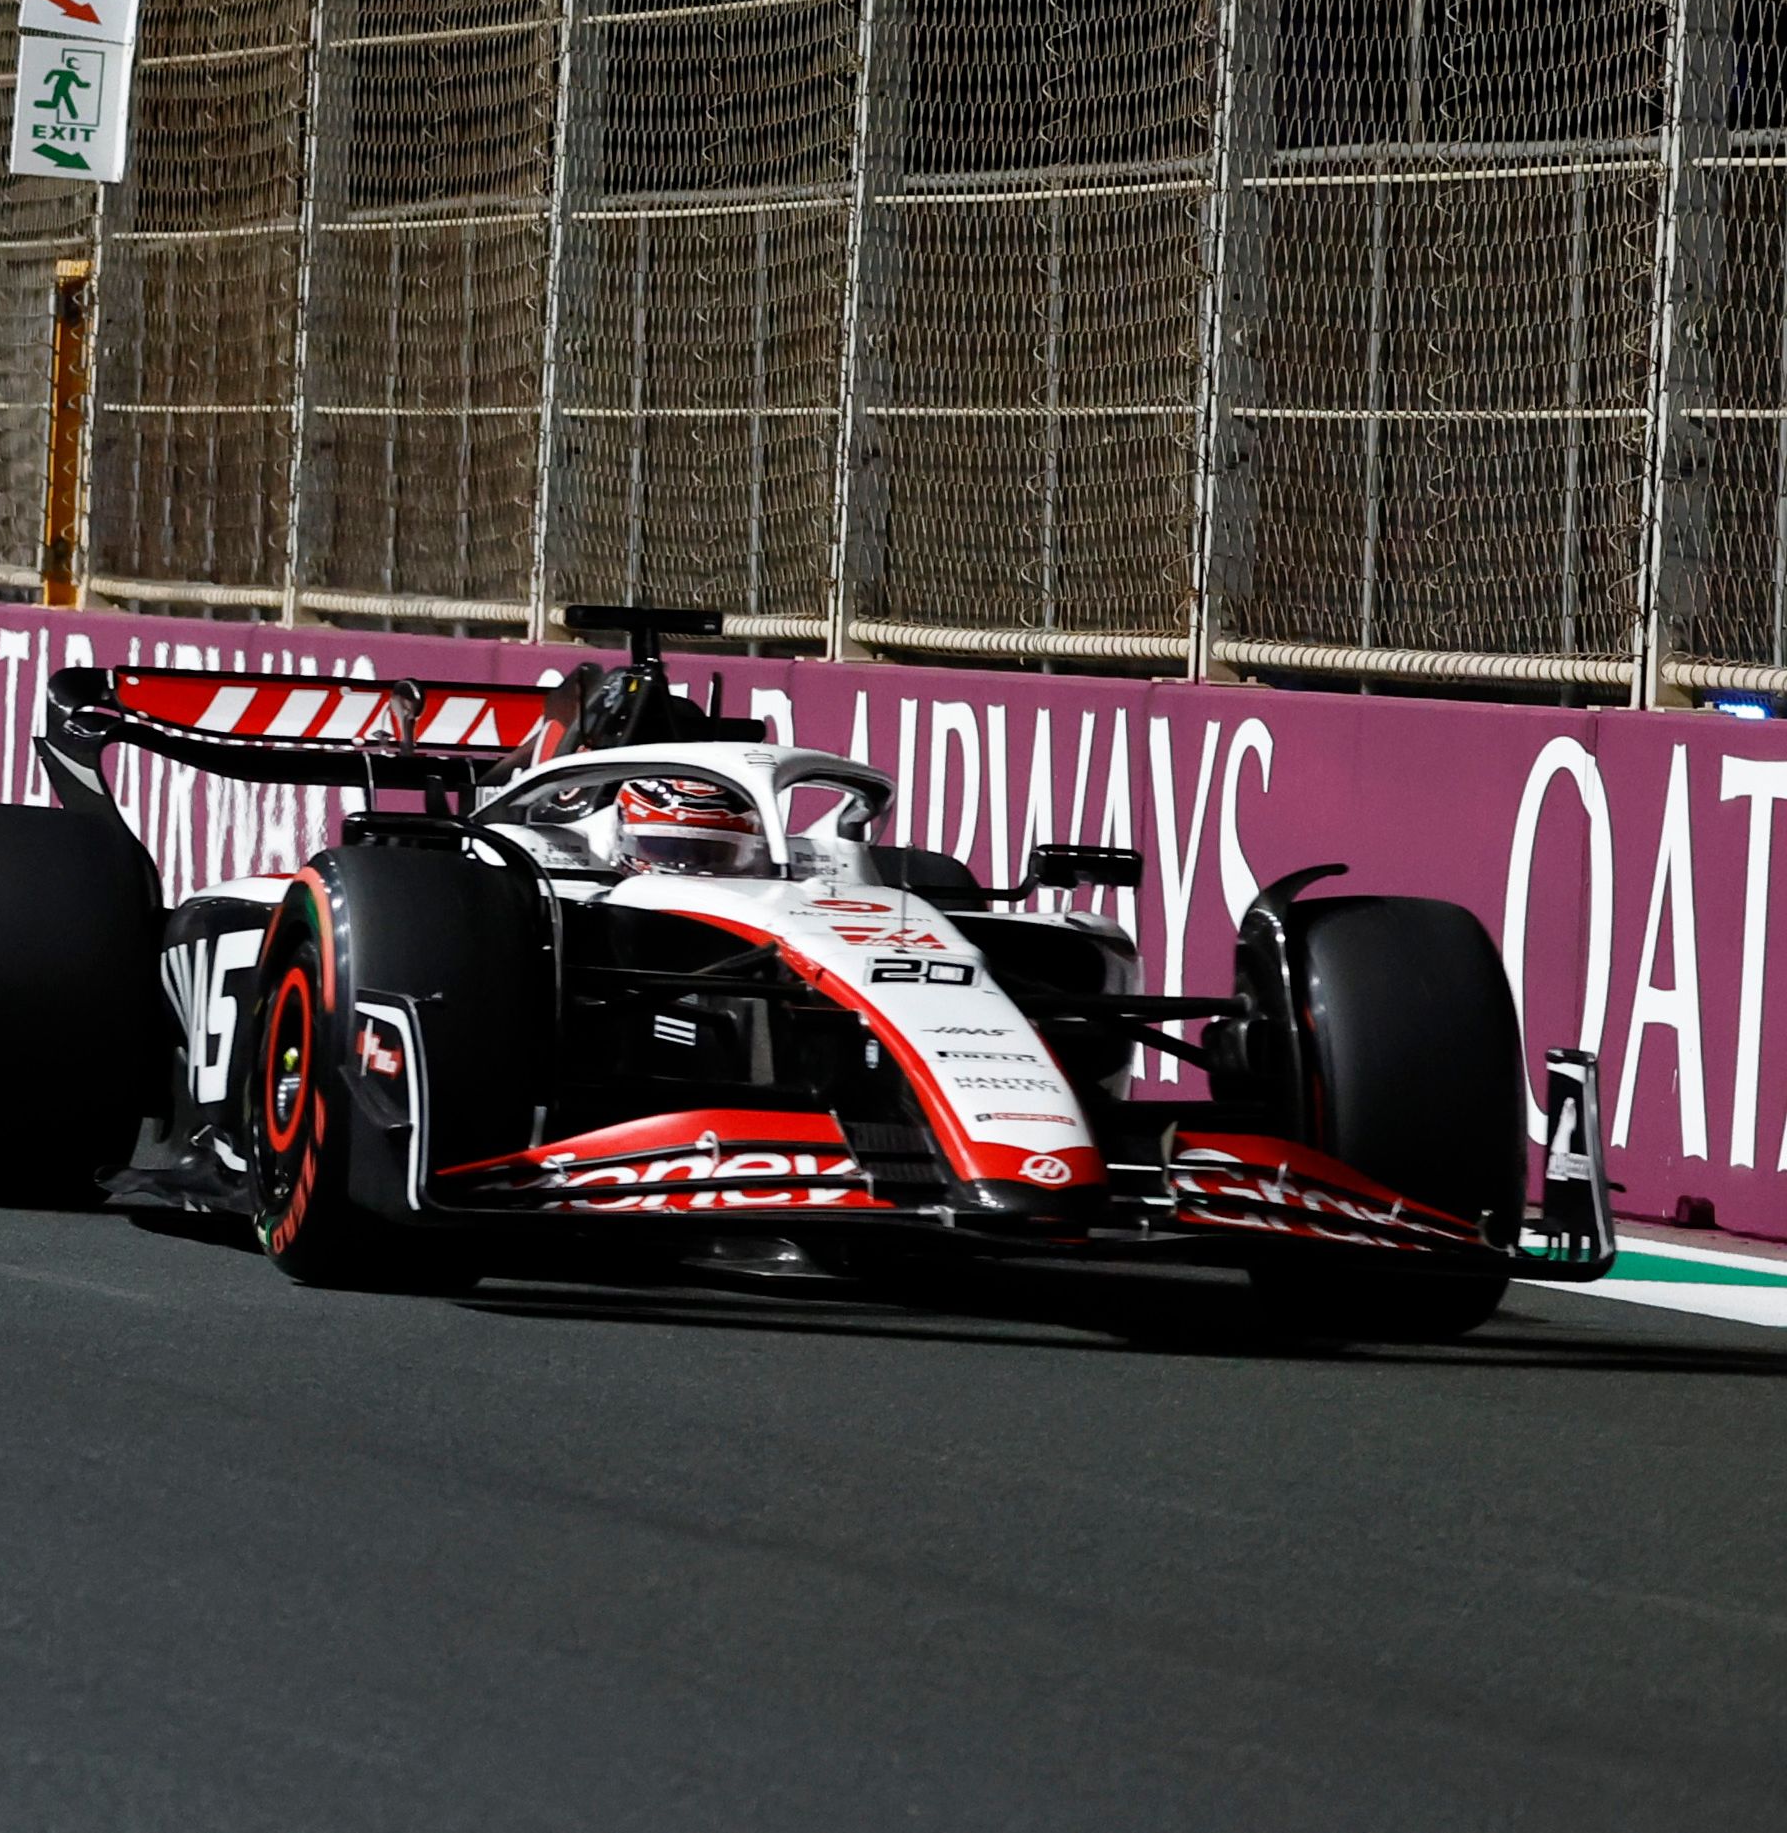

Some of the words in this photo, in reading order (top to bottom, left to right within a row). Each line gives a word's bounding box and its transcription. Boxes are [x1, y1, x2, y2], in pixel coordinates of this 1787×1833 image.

[31, 124, 97, 143] EXIT
[871, 958, 976, 986] 20
[1502, 735, 1787, 1173] QAT
[541, 1151, 858, 1209] oney
